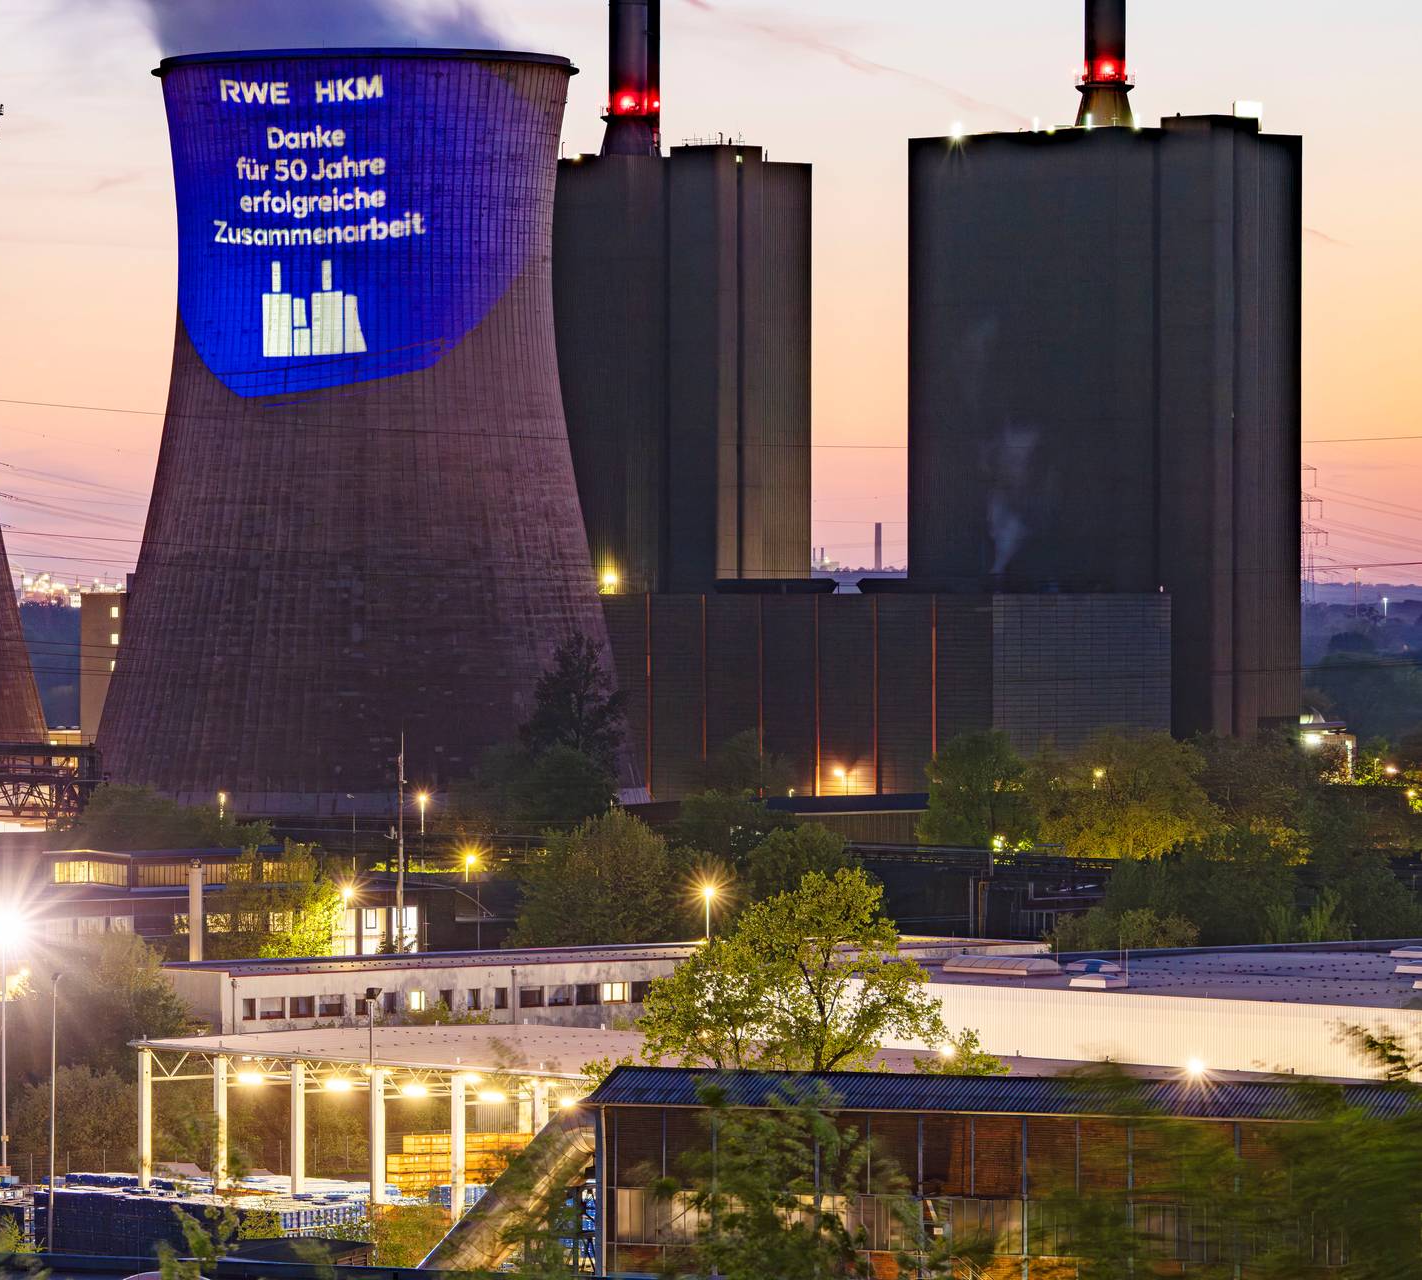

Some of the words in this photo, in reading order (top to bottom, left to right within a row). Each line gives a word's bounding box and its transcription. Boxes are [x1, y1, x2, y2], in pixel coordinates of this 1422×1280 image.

[221, 80, 289, 104] RWE
[315, 75, 384, 103] HKM
[267, 125, 346, 149] Danke
[236, 157, 269, 181] für
[275, 159, 307, 181] 50
[311, 155, 386, 181] Jahre
[240, 187, 386, 218] erfolgreiche
[213, 211, 426, 246] Zusammenarbeit
